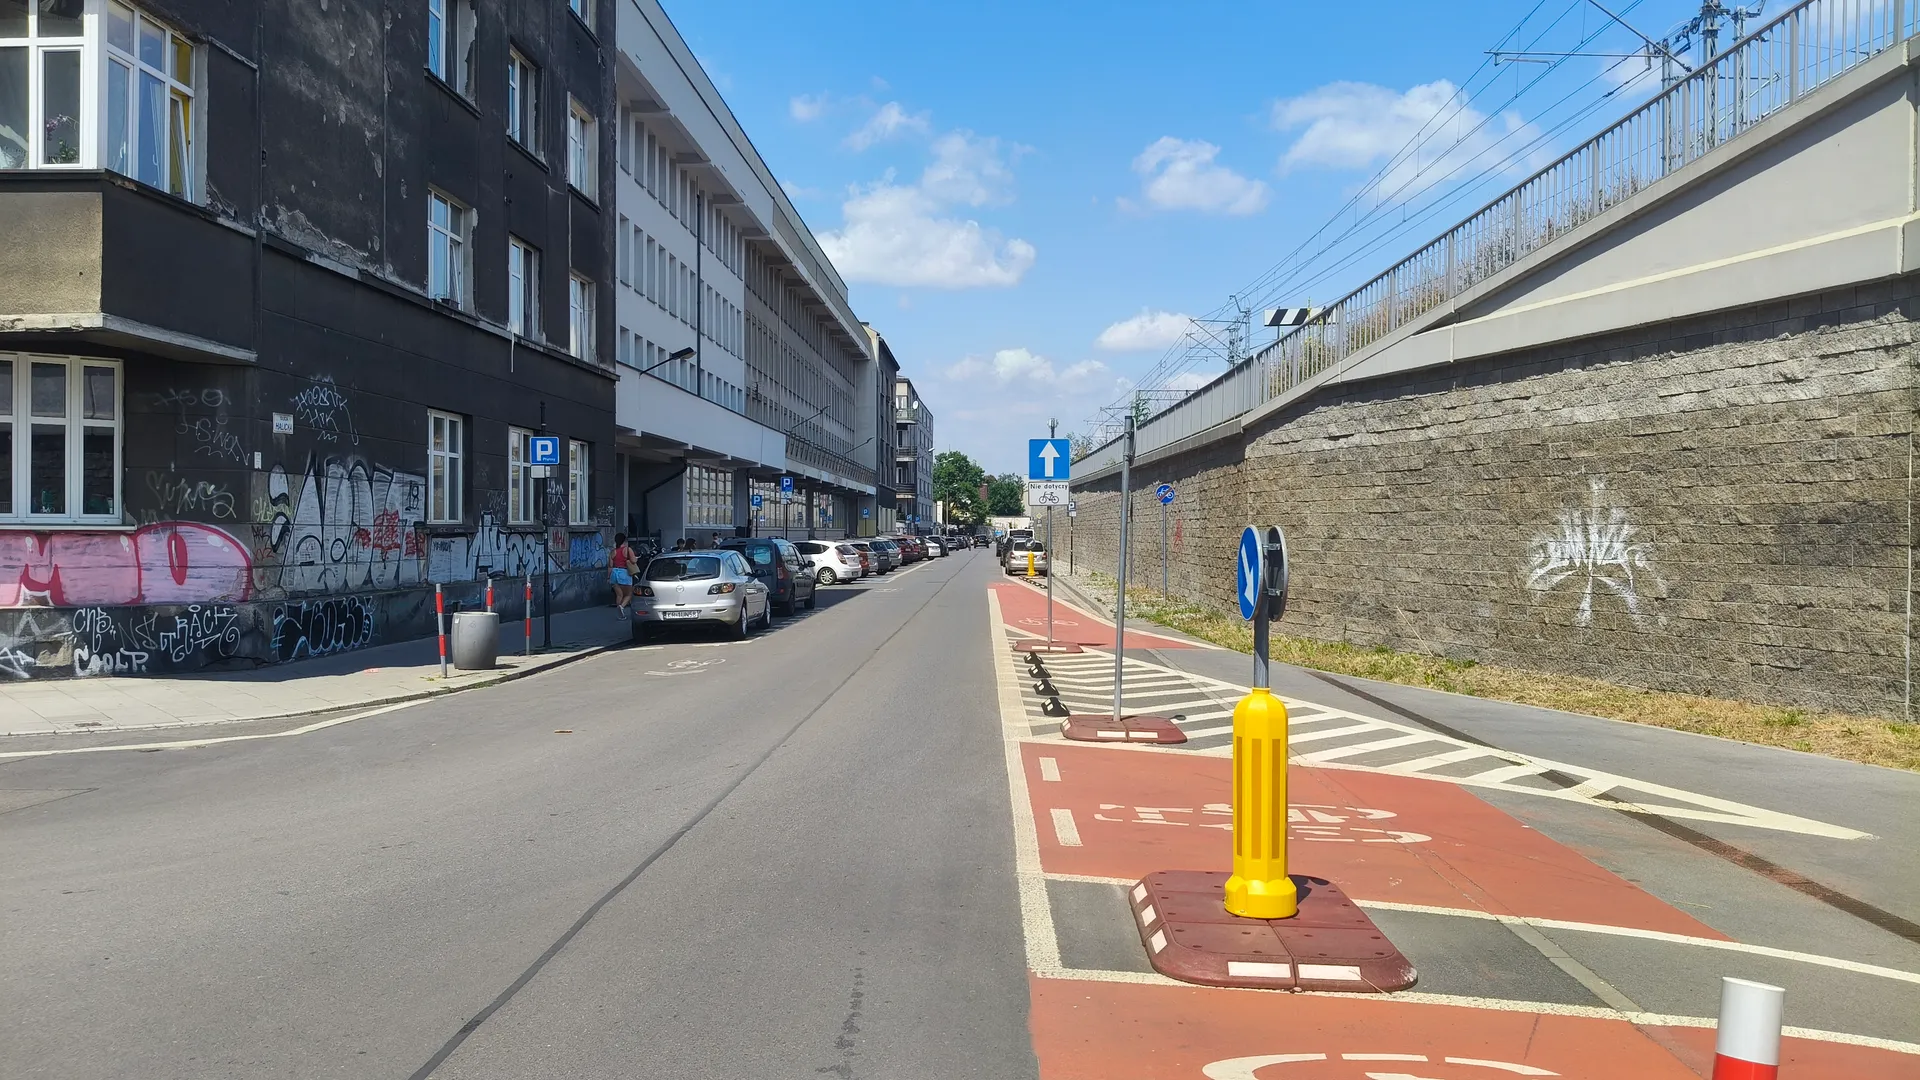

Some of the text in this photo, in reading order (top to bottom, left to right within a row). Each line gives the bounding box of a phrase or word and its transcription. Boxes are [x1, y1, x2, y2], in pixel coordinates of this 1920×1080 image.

[536, 440, 552, 461] P
[783, 478, 790, 488] P
[754, 496, 761, 504] P
